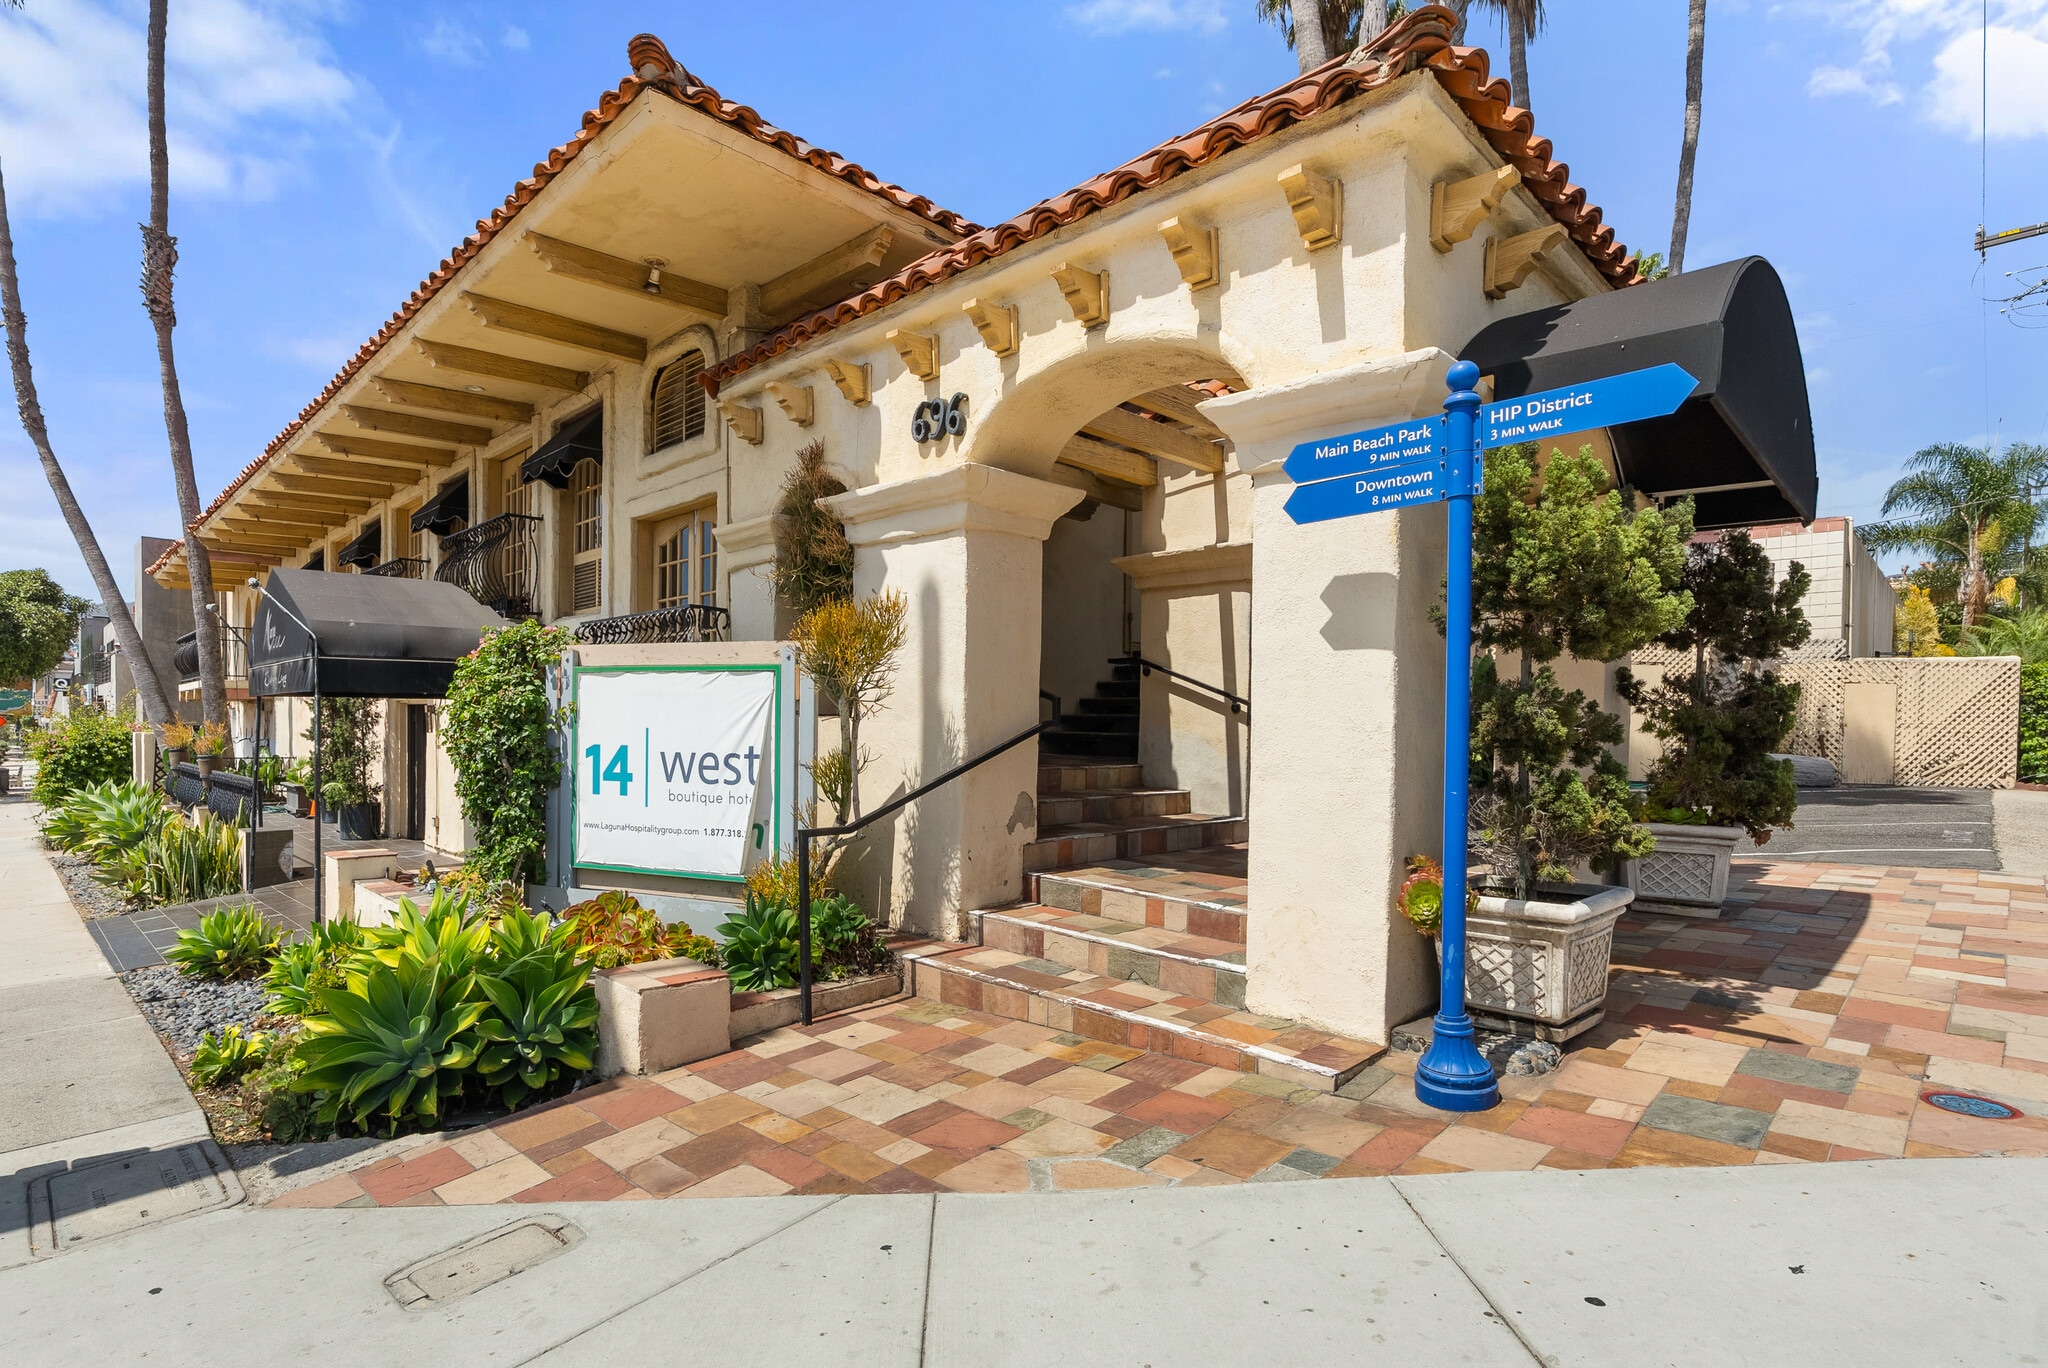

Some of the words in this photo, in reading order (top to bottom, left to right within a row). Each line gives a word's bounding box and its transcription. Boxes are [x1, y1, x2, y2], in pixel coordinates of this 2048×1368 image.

[911, 392, 970, 444] 696
[1490, 405, 1522, 424] HIP
[1527, 392, 1593, 417] District
[1490, 429, 1498, 440] 3
[1501, 426, 1525, 438] MIN
[1528, 418, 1563, 432] WALK
[1315, 443, 1349, 460] Main
[1353, 432, 1394, 453] Beach
[1398, 424, 1432, 443] Park
[1369, 453, 1377, 464] 9
[1380, 451, 1400, 462] MIN
[1402, 444, 1432, 457] WALK
[1355, 471, 1433, 494] Downtown
[1371, 495, 1379, 506] 8
[1381, 493, 1401, 504] MIN
[1404, 487, 1433, 500] WALK
[55, 679, 68, 690] Q
[585, 744, 633, 796] 14
[660, 746, 760, 786] west
[668, 789, 723, 806] boutique
[728, 791, 753, 805] hot
[583, 821, 700, 837] www.LagunaHospitalitygroup.com
[704, 828, 747, 838] 1.877.318.
